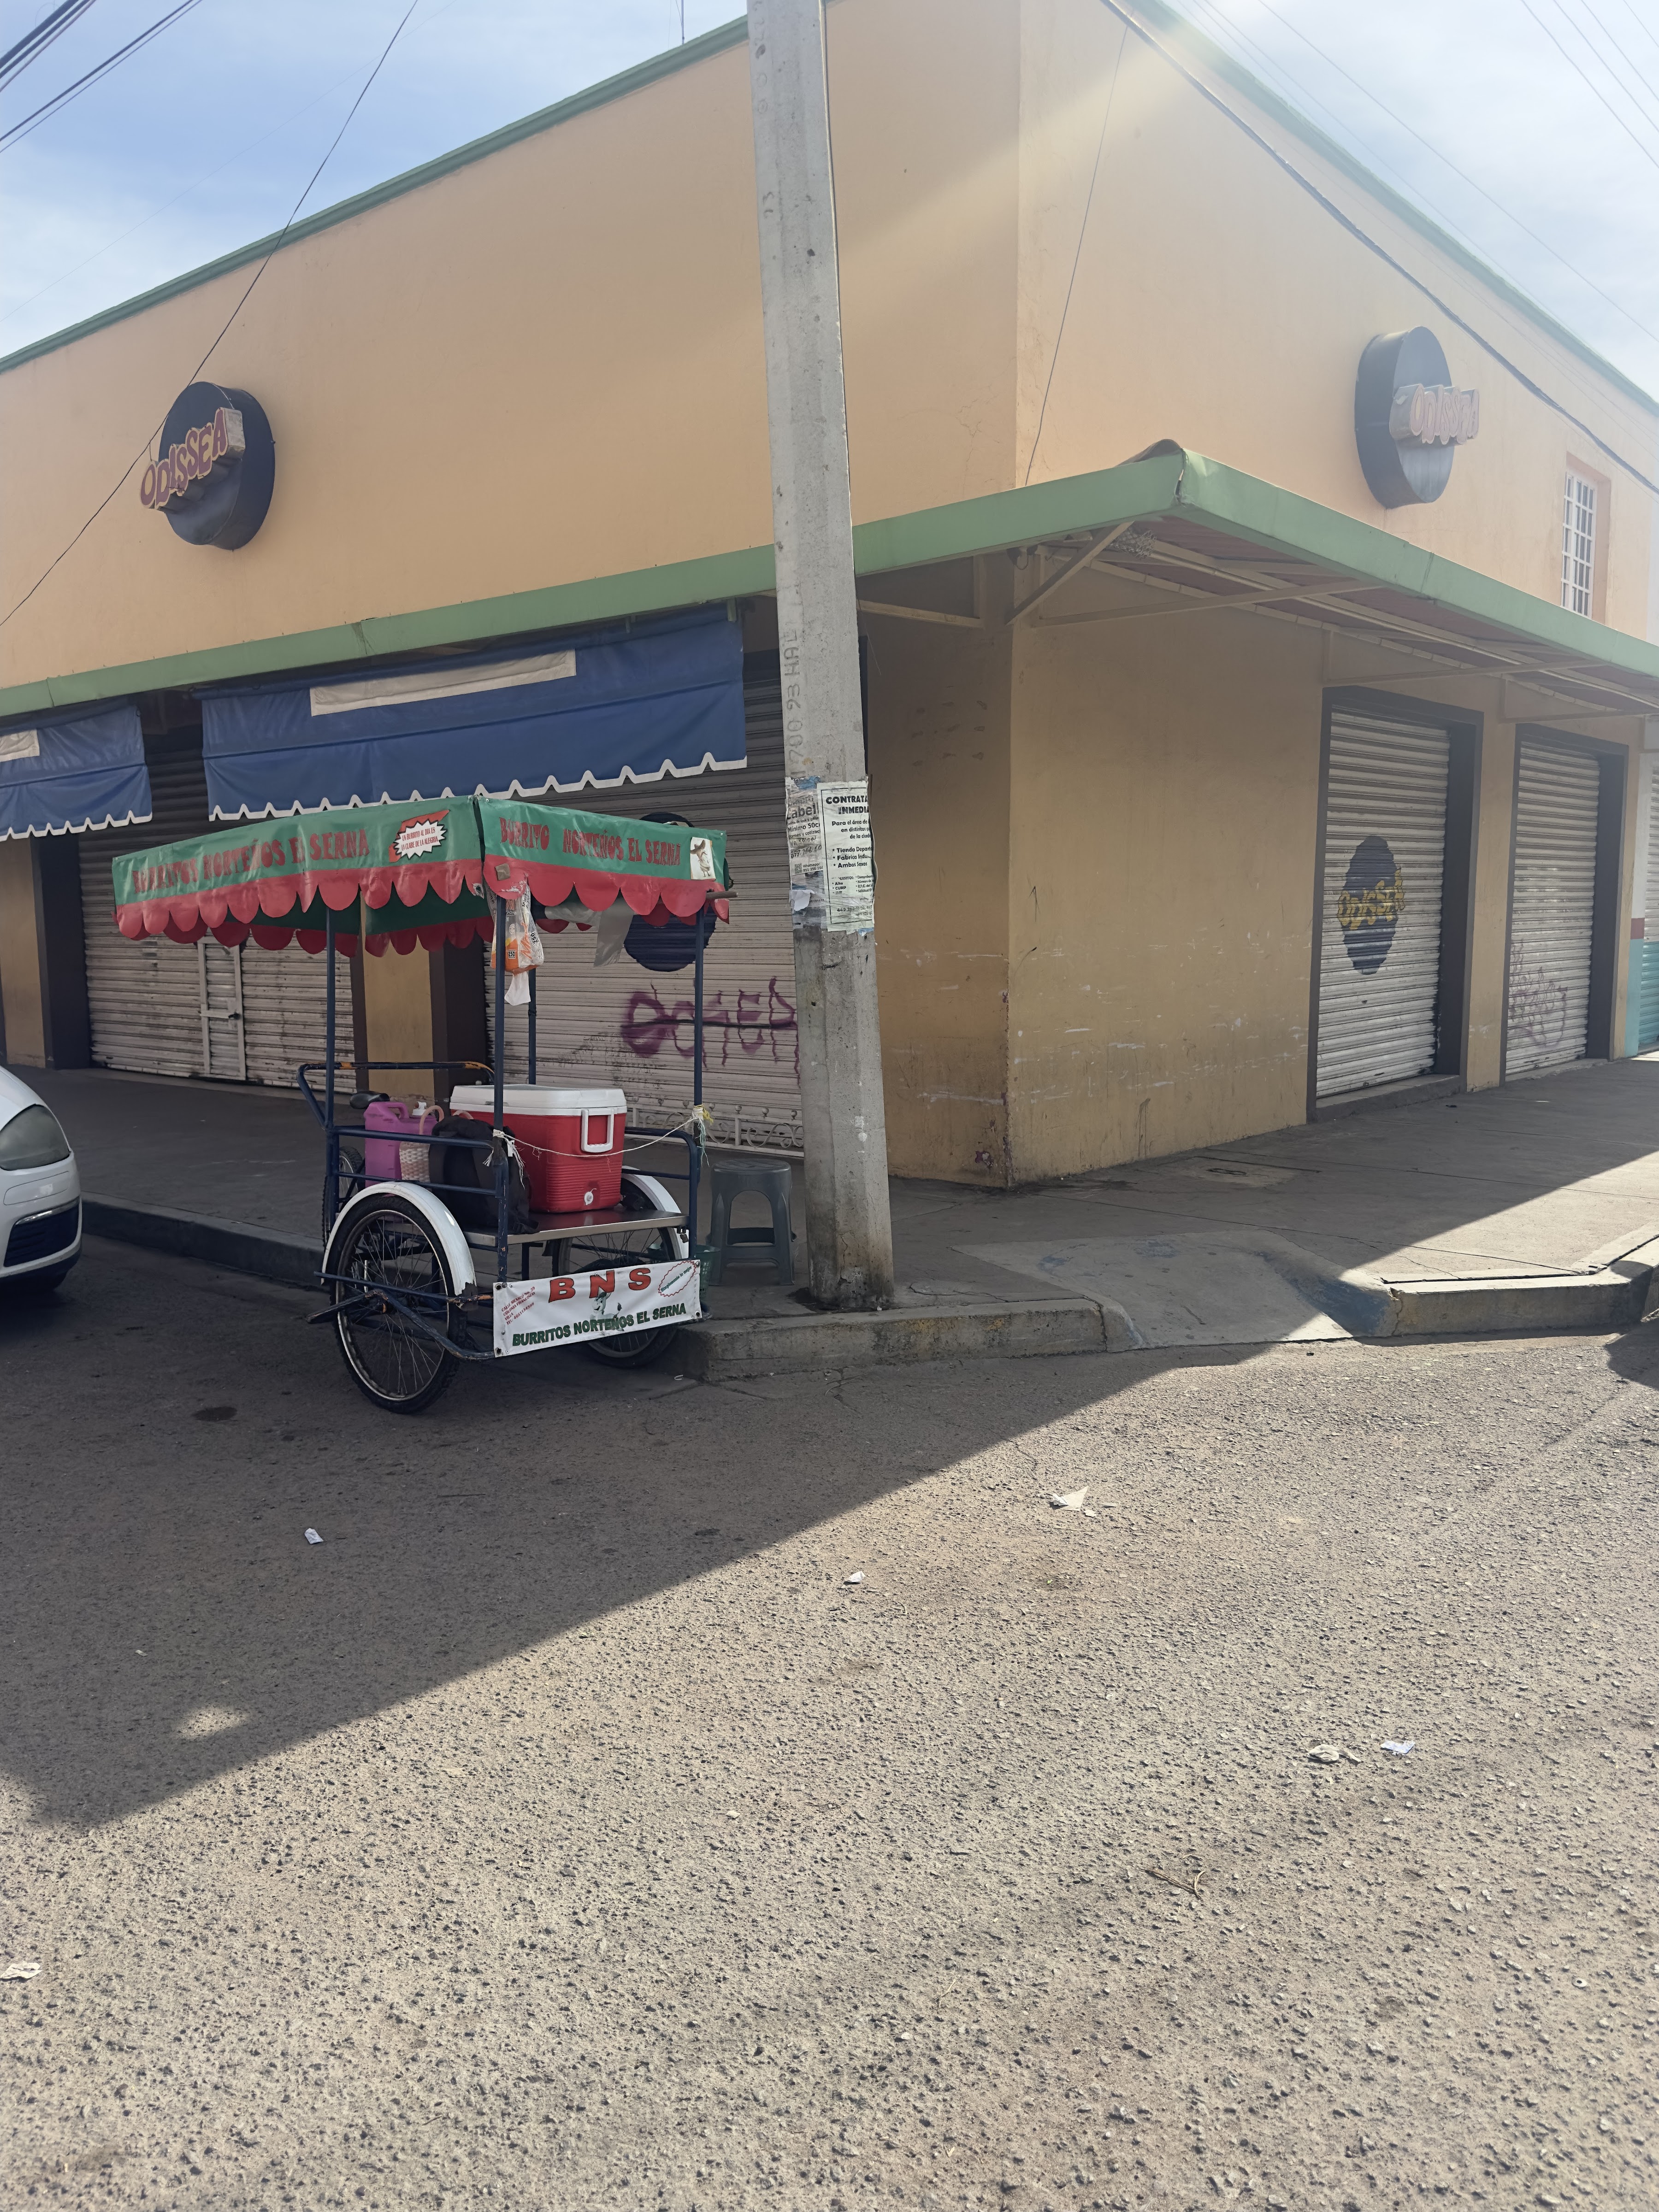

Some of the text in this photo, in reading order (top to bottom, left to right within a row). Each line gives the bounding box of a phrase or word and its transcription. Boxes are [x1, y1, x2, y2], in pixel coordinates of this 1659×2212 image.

[140, 407, 229, 510] ODISSEA
[310, 829, 370, 861] SERNA
[499, 817, 550, 851] BURRITO
[627, 837, 642, 862] EL
[645, 839, 681, 866] SERNA
[510, 1294, 525, 1305] MEXICO
[512, 1324, 571, 1347] BURRITOS
[636, 1311, 650, 1324] EL
[652, 1303, 687, 1320] SERNA
